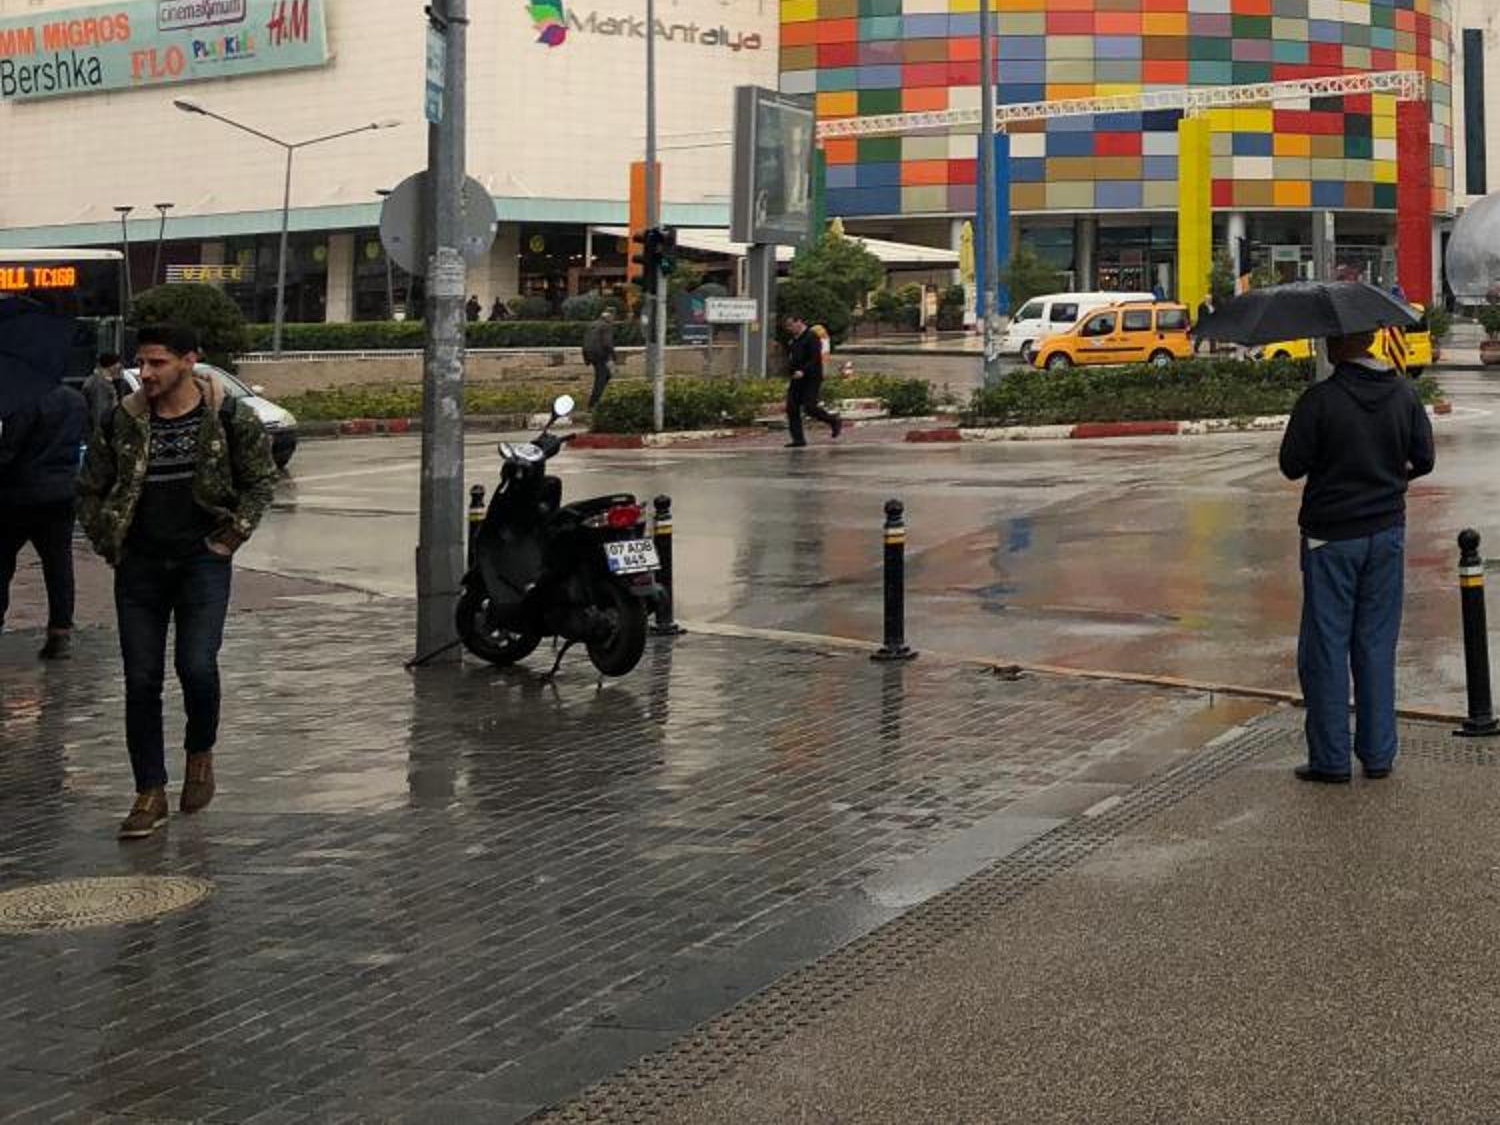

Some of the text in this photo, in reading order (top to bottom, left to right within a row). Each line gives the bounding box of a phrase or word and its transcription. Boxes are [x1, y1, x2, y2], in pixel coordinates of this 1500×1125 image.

[566, 9, 762, 52] MarkAntalya
[0, 49, 102, 97] Bershka
[131, 45, 186, 81] FLO
